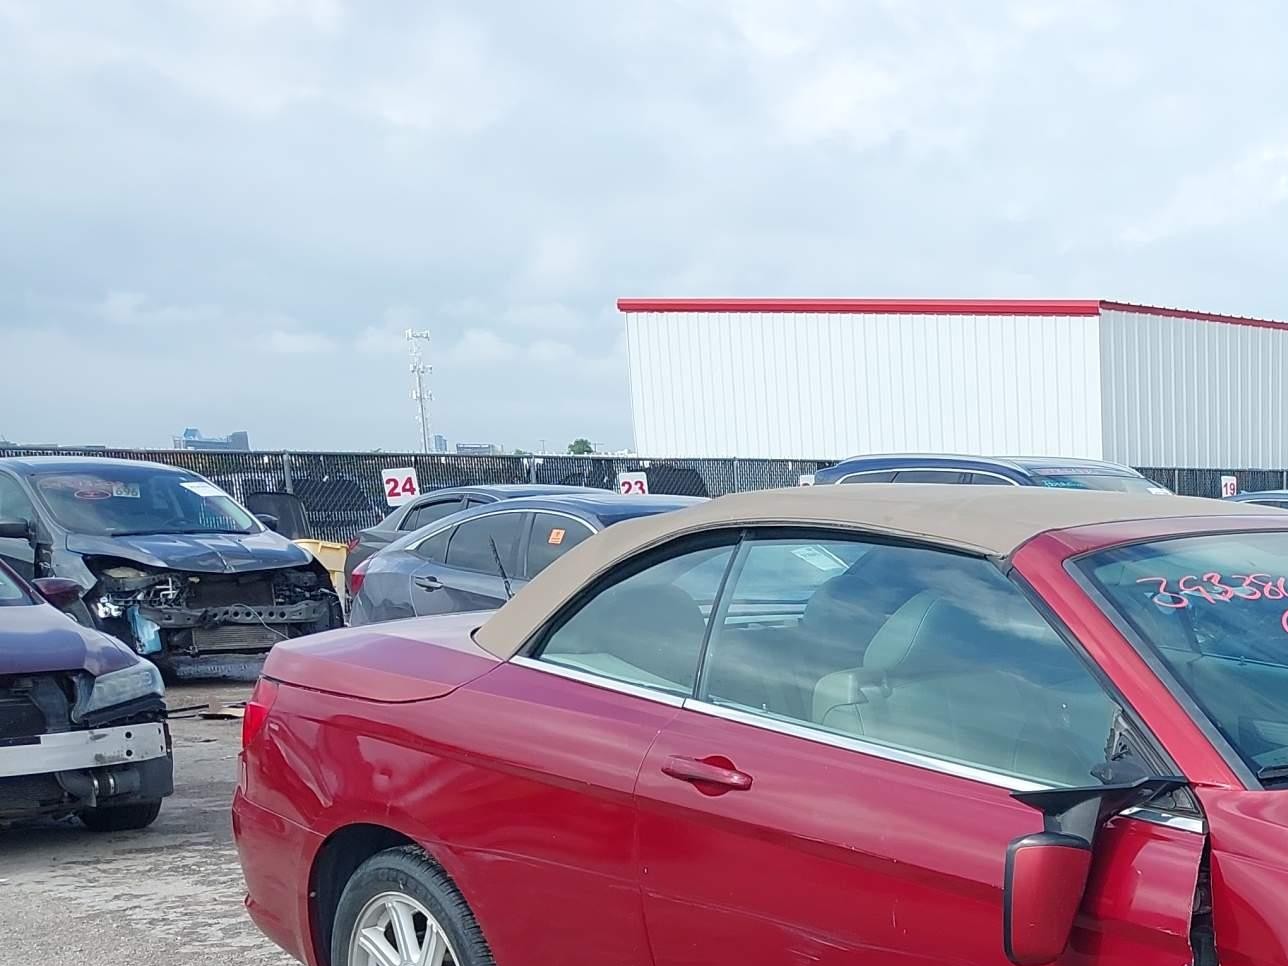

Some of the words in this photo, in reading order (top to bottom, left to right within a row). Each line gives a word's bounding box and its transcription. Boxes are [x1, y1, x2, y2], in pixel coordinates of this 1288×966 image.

[385, 477, 416, 497] 24
[621, 480, 646, 494] 23
[1223, 482, 1236, 496] 19
